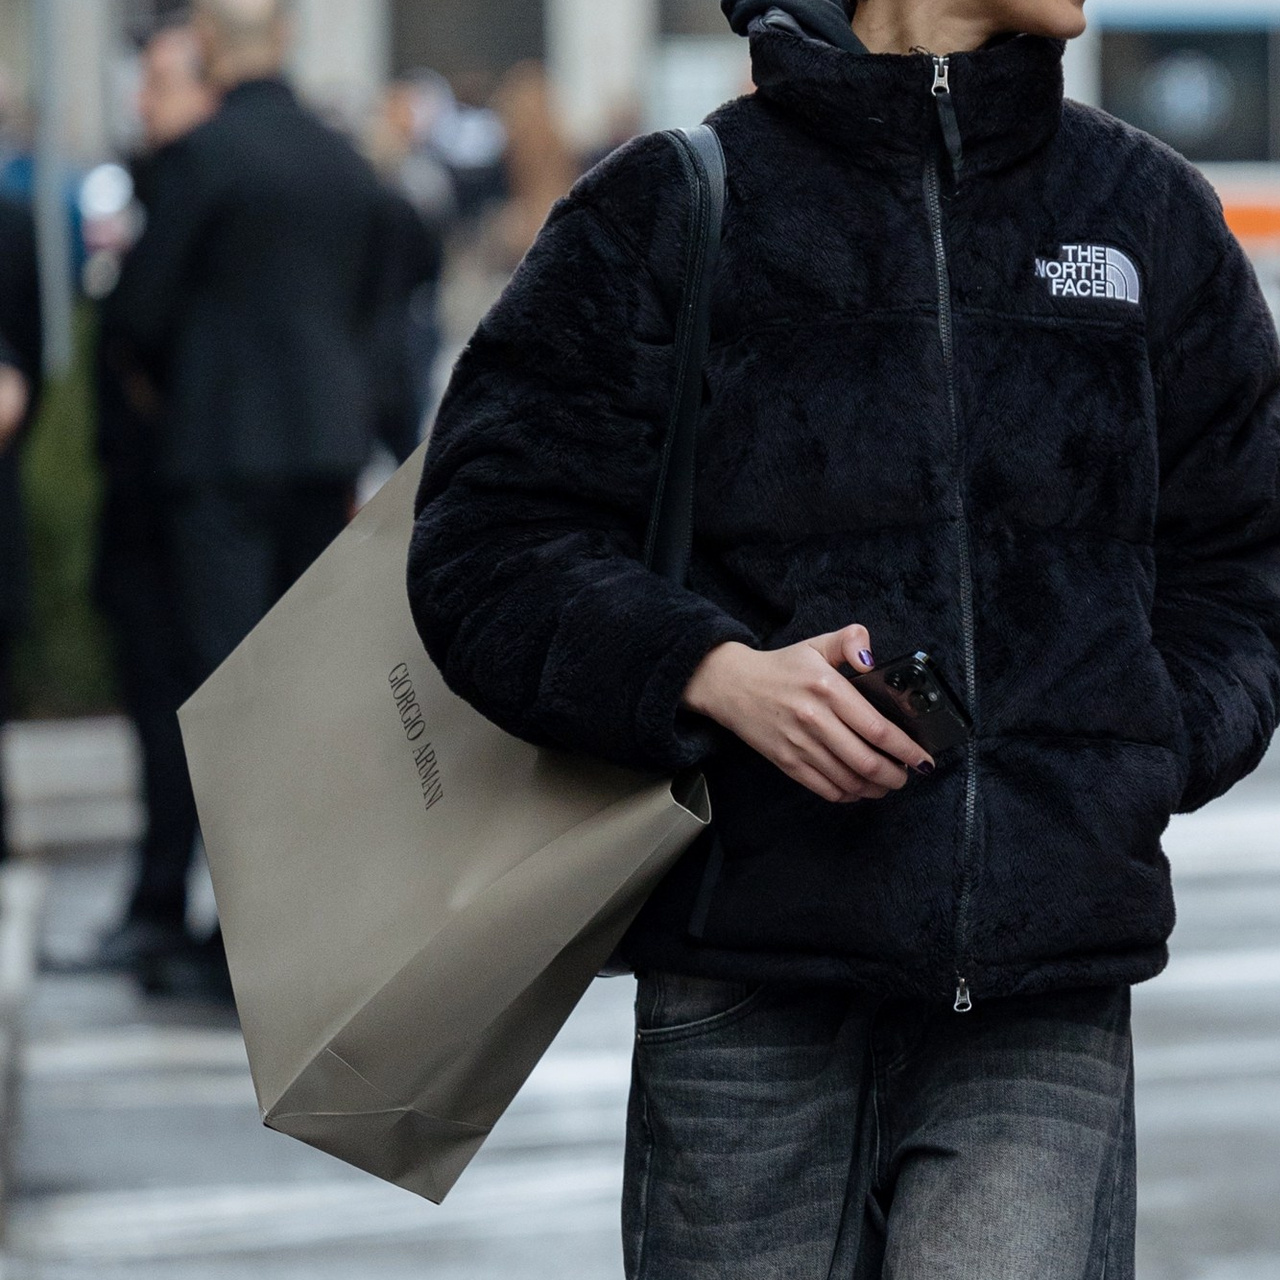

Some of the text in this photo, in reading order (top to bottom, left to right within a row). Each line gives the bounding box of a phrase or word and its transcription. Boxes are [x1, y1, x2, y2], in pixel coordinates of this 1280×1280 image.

[1062, 245, 1106, 264] THE
[1034, 257, 1106, 280] NORTH
[1051, 278, 1106, 298] FACE
[387, 662, 444, 811] GIORGIO ARMANI
